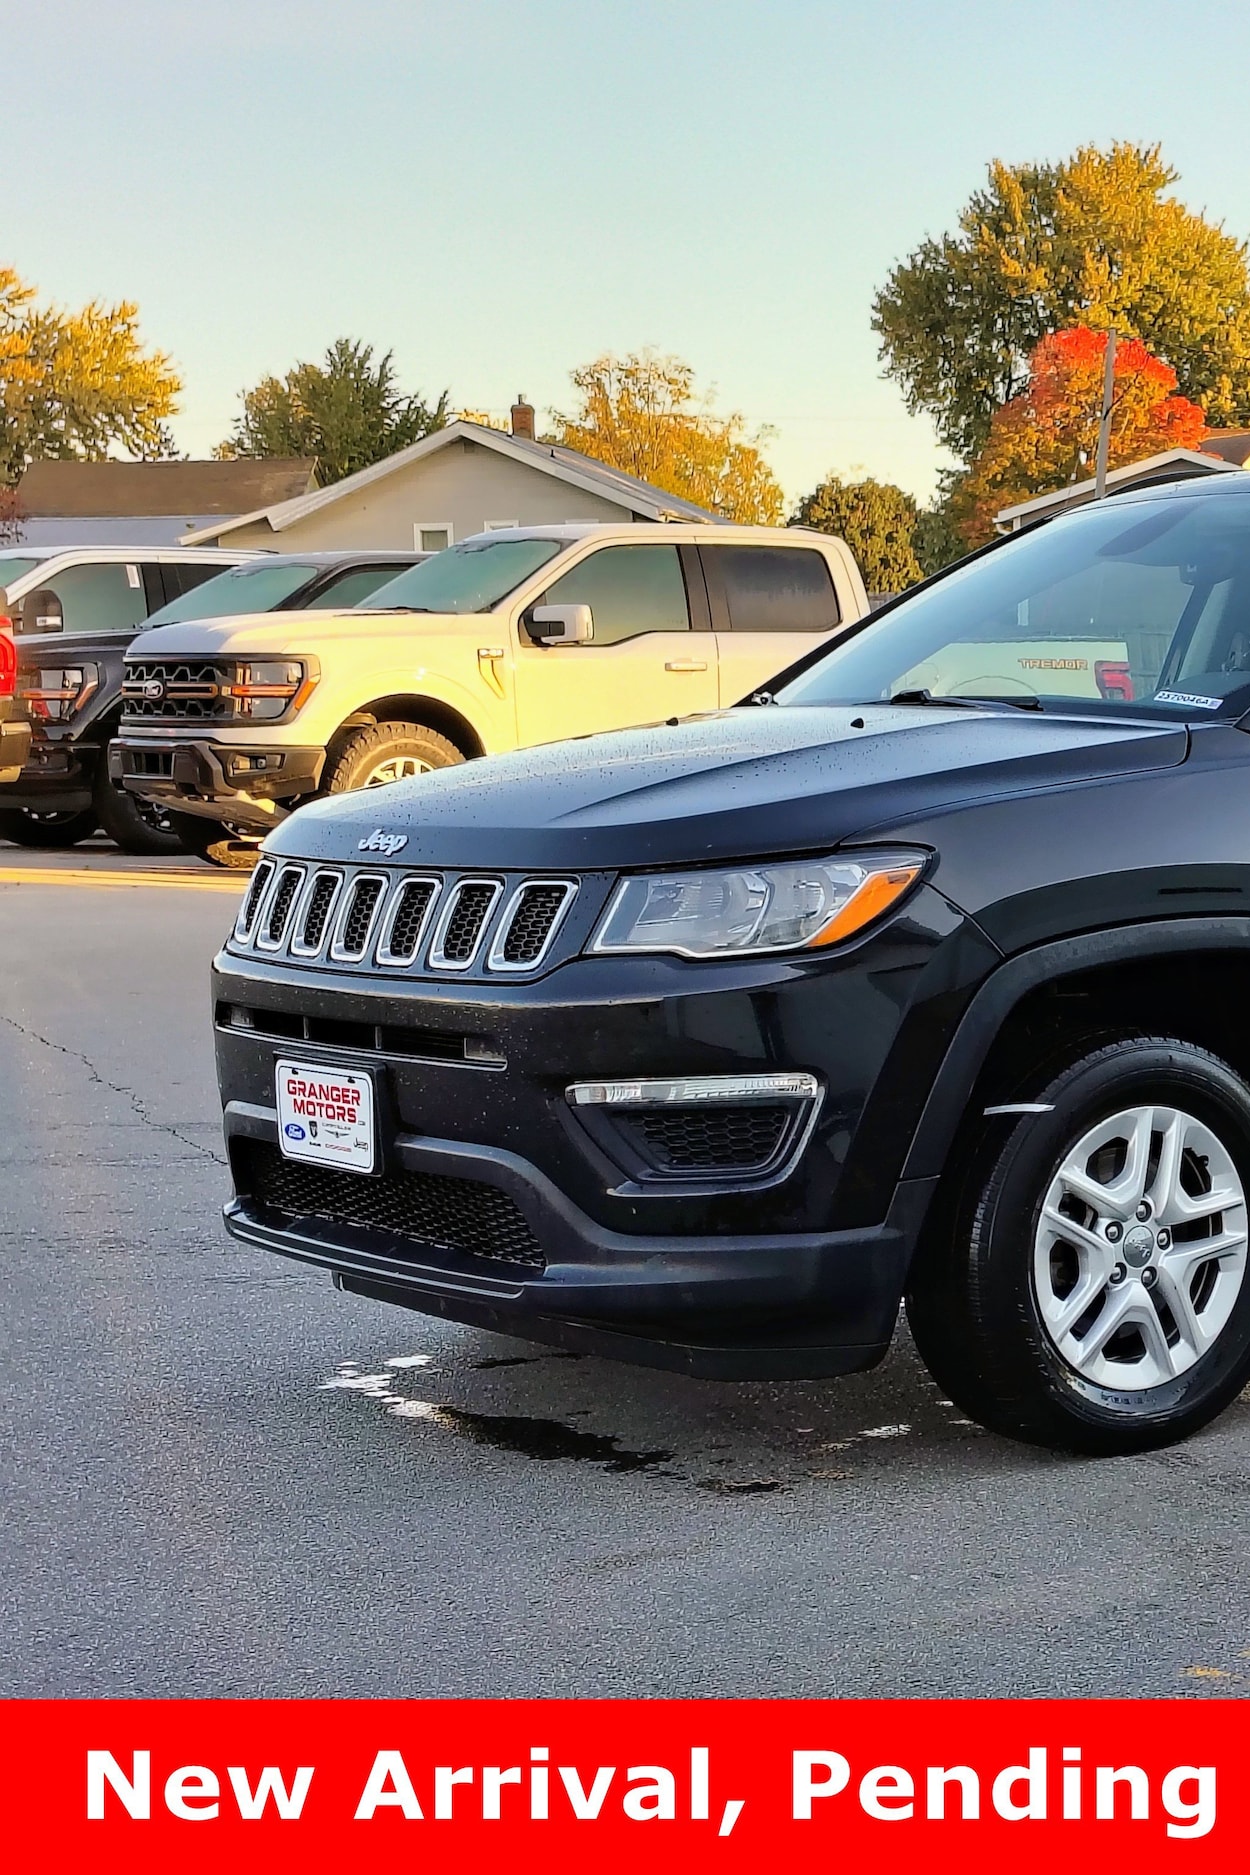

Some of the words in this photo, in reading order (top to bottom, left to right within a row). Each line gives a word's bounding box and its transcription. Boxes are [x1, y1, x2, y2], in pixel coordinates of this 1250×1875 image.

[1017, 658, 1089, 671] TREMOR
[357, 828, 409, 857] Jeep
[287, 1079, 361, 1106] GRANGER
[293, 1098, 357, 1124] MOTORS
